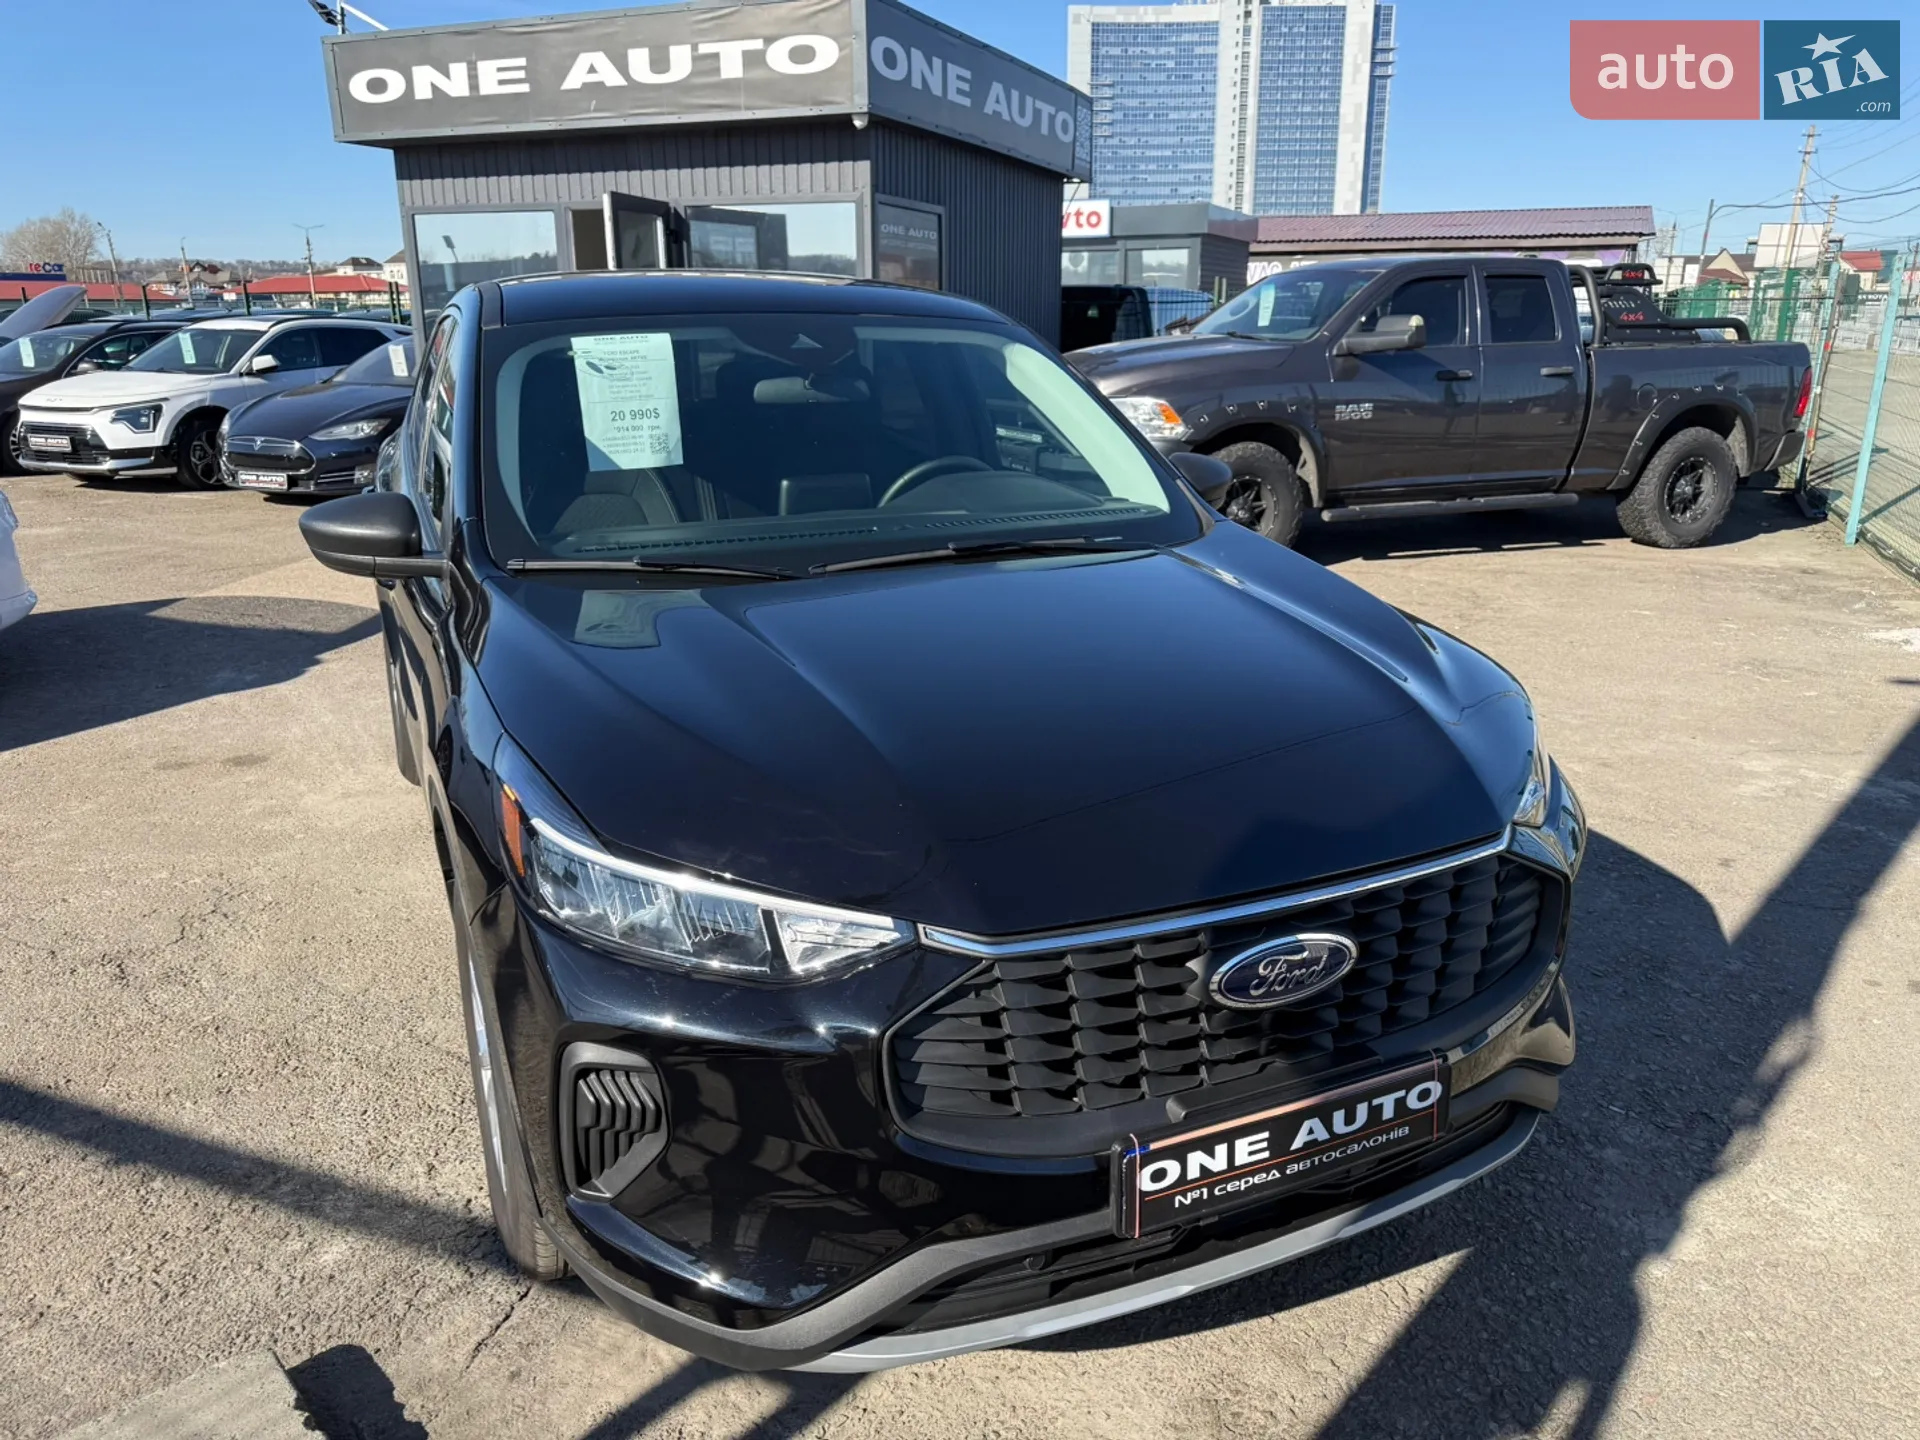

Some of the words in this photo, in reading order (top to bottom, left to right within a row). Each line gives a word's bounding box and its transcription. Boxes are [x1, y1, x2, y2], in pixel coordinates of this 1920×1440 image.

[348, 57, 530, 103] ONE
[560, 35, 839, 90] AUTO
[870, 36, 972, 107] ONE
[983, 81, 1075, 143] AUTO
[881, 224, 905, 235] ONE
[908, 228, 937, 240] AUTO
[610, 410, 626, 422] 20
[629, 407, 660, 421] 990$
[1249, 950, 1327, 996] Ford
[1139, 1131, 1270, 1192] ONE
[1289, 1081, 1443, 1151] AUTO
[1213, 1169, 1282, 1196] серед
[1285, 1126, 1410, 1175] автосалонів
